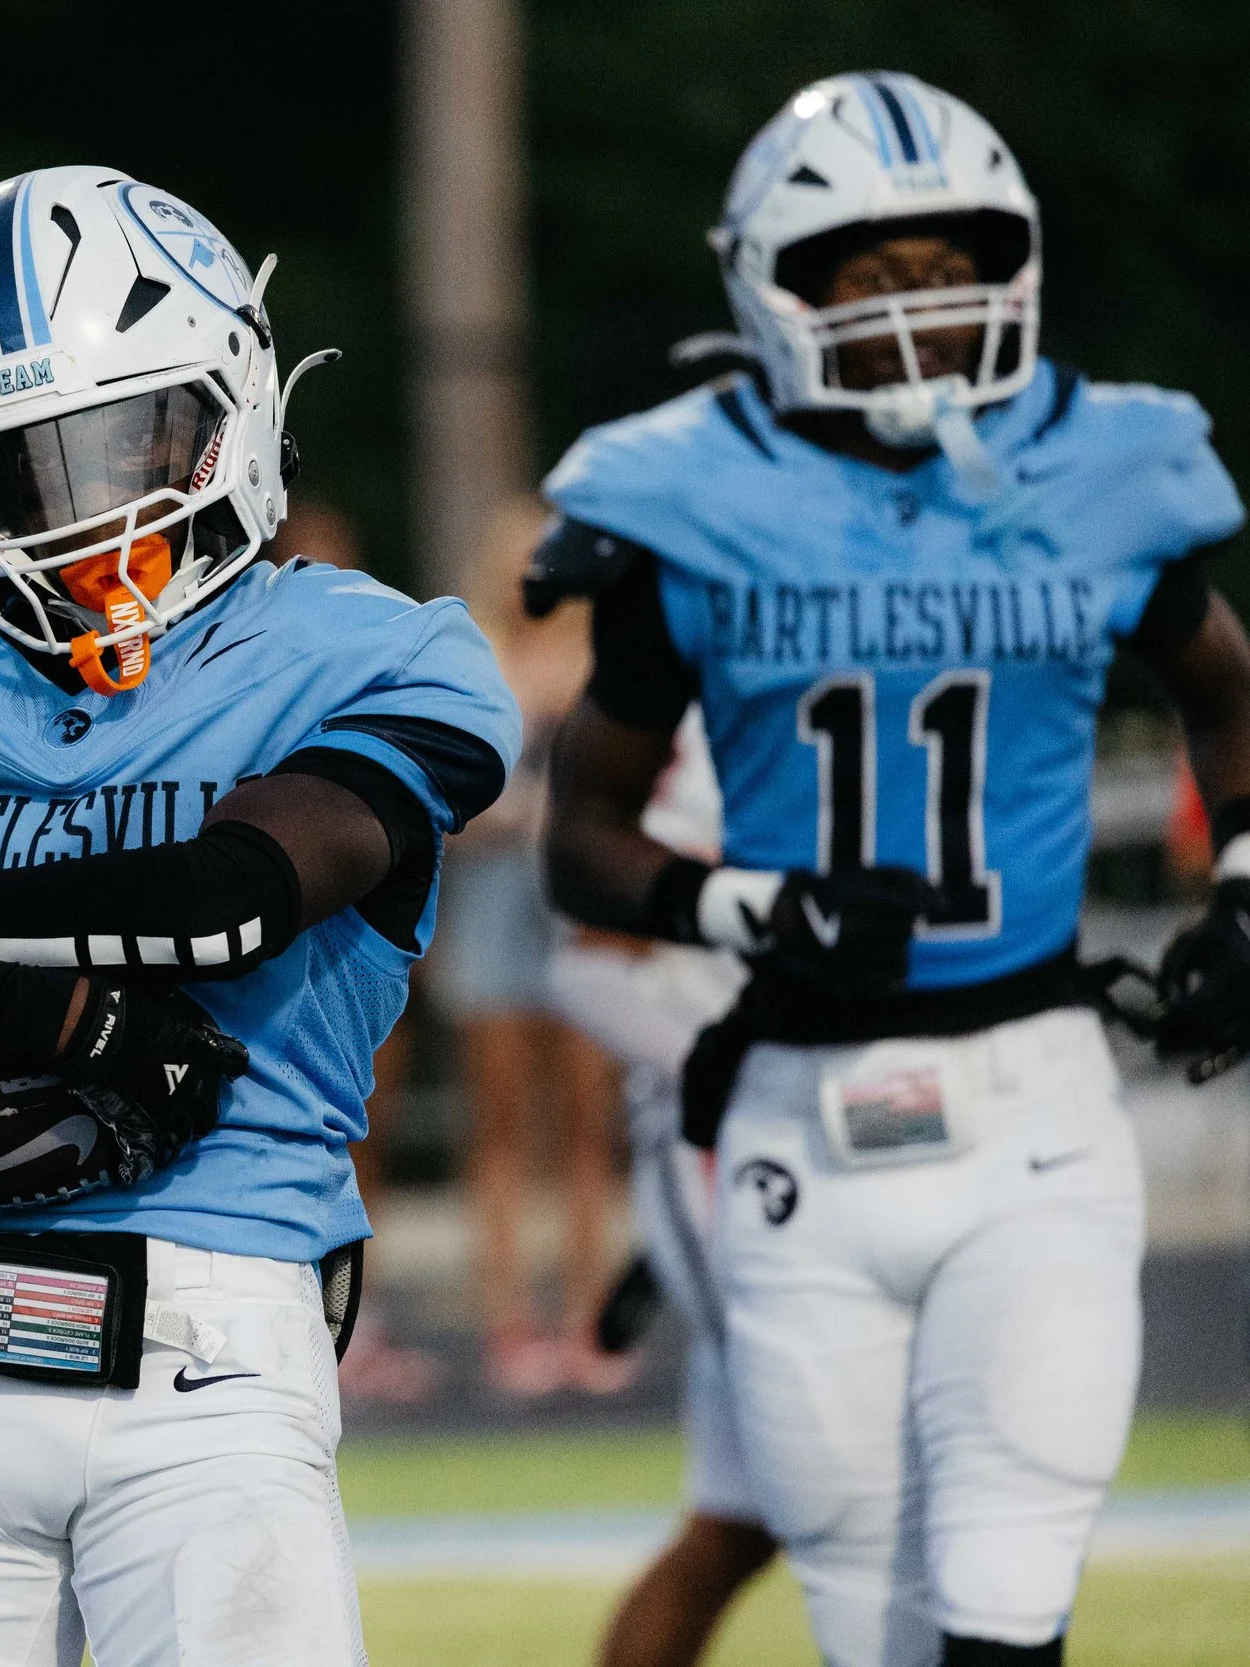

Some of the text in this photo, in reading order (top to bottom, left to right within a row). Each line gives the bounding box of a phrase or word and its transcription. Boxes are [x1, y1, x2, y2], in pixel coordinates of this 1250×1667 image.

[110, 600, 145, 676] NXRND
[796, 668, 1002, 940] 11
[90, 1013, 117, 1059] RIVEL
